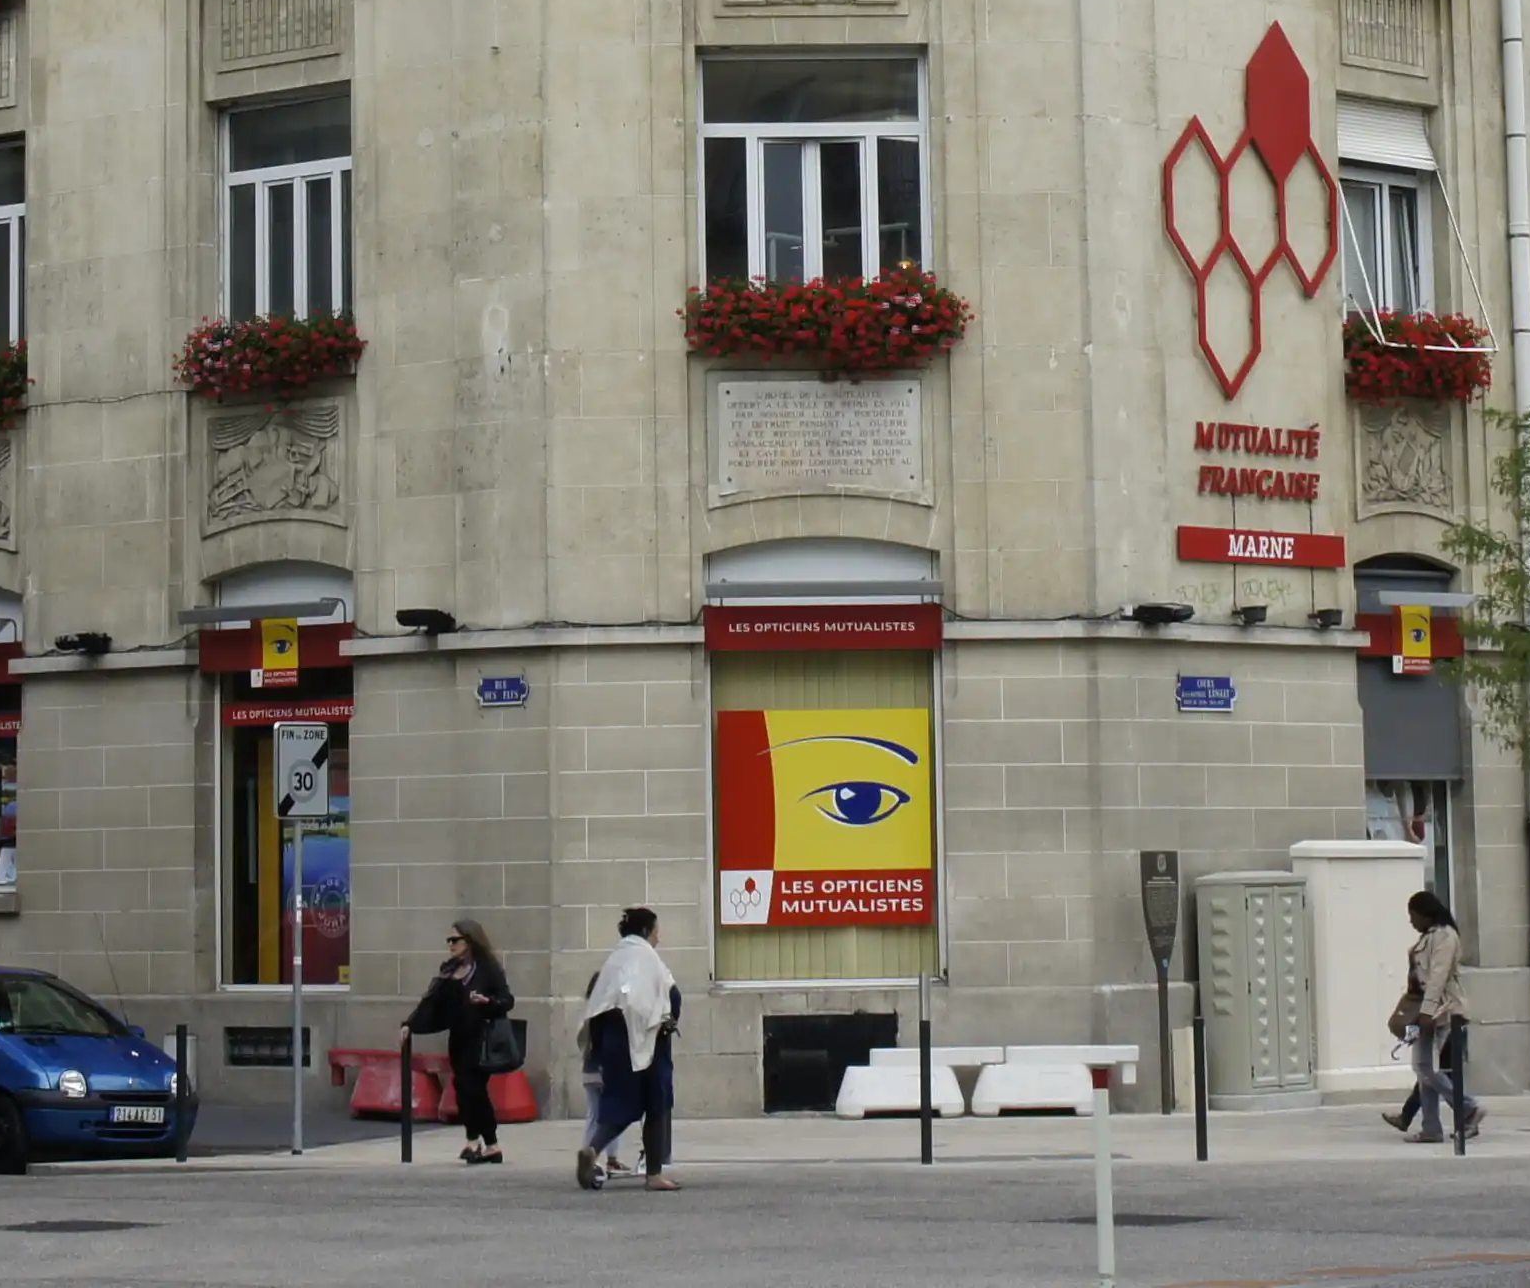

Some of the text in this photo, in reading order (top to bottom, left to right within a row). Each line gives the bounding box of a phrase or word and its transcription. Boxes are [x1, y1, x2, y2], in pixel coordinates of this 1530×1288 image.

[1194, 422, 1320, 459] MUTUALITÉ
[1198, 465, 1320, 501] FRANÇAISE
[1228, 534, 1295, 560] MARNE
[729, 621, 916, 632] LES OPTICIENS MUTUALISTES
[233, 706, 354, 720] LES OPTICIENS MUTUALISTES
[281, 730, 294, 740] FIN
[303, 730, 325, 740] ZONE
[294, 772, 313, 791] 30
[781, 879, 924, 894] LES OPTICIENS
[781, 898, 924, 913] MUTUALISTES
